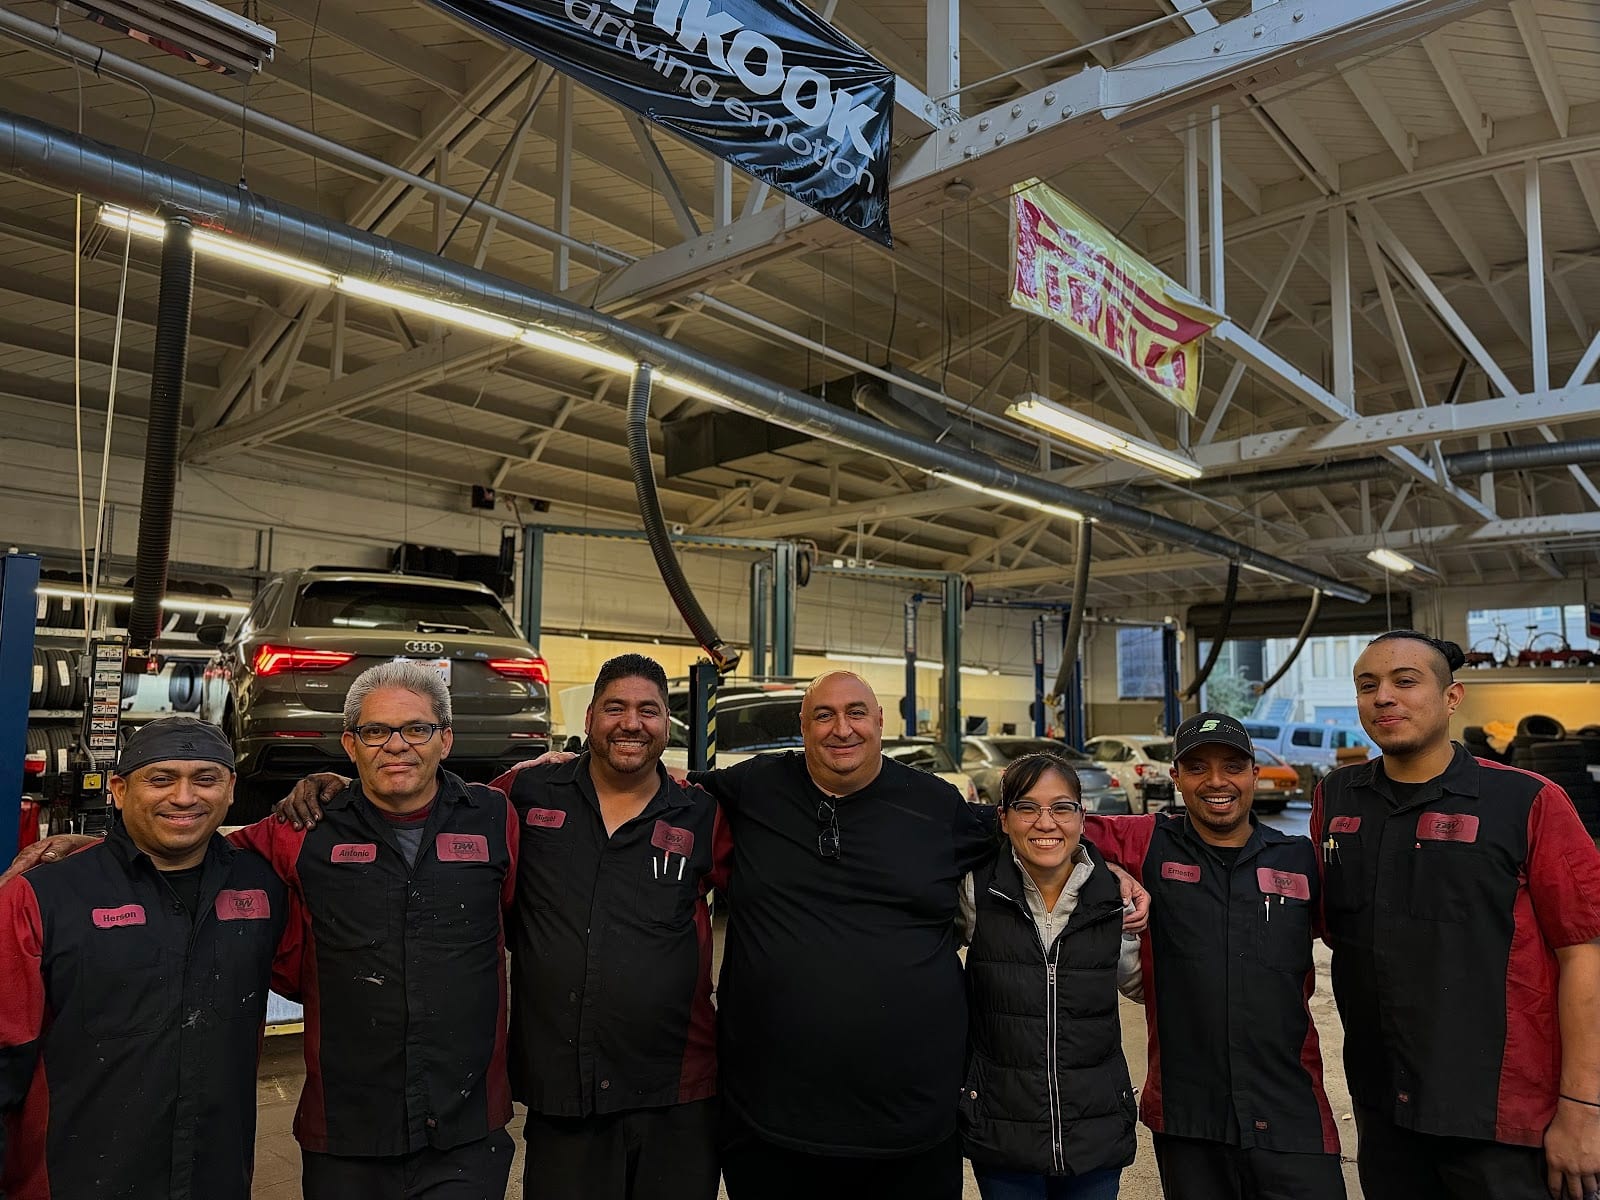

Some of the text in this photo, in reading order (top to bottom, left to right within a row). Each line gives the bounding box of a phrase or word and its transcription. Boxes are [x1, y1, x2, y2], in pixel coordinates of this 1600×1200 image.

[724, 96, 875, 194] emotion
[339, 847, 370, 857] Antonio
[1167, 867, 1194, 878] Ernesto
[103, 911, 137, 922] Herson
